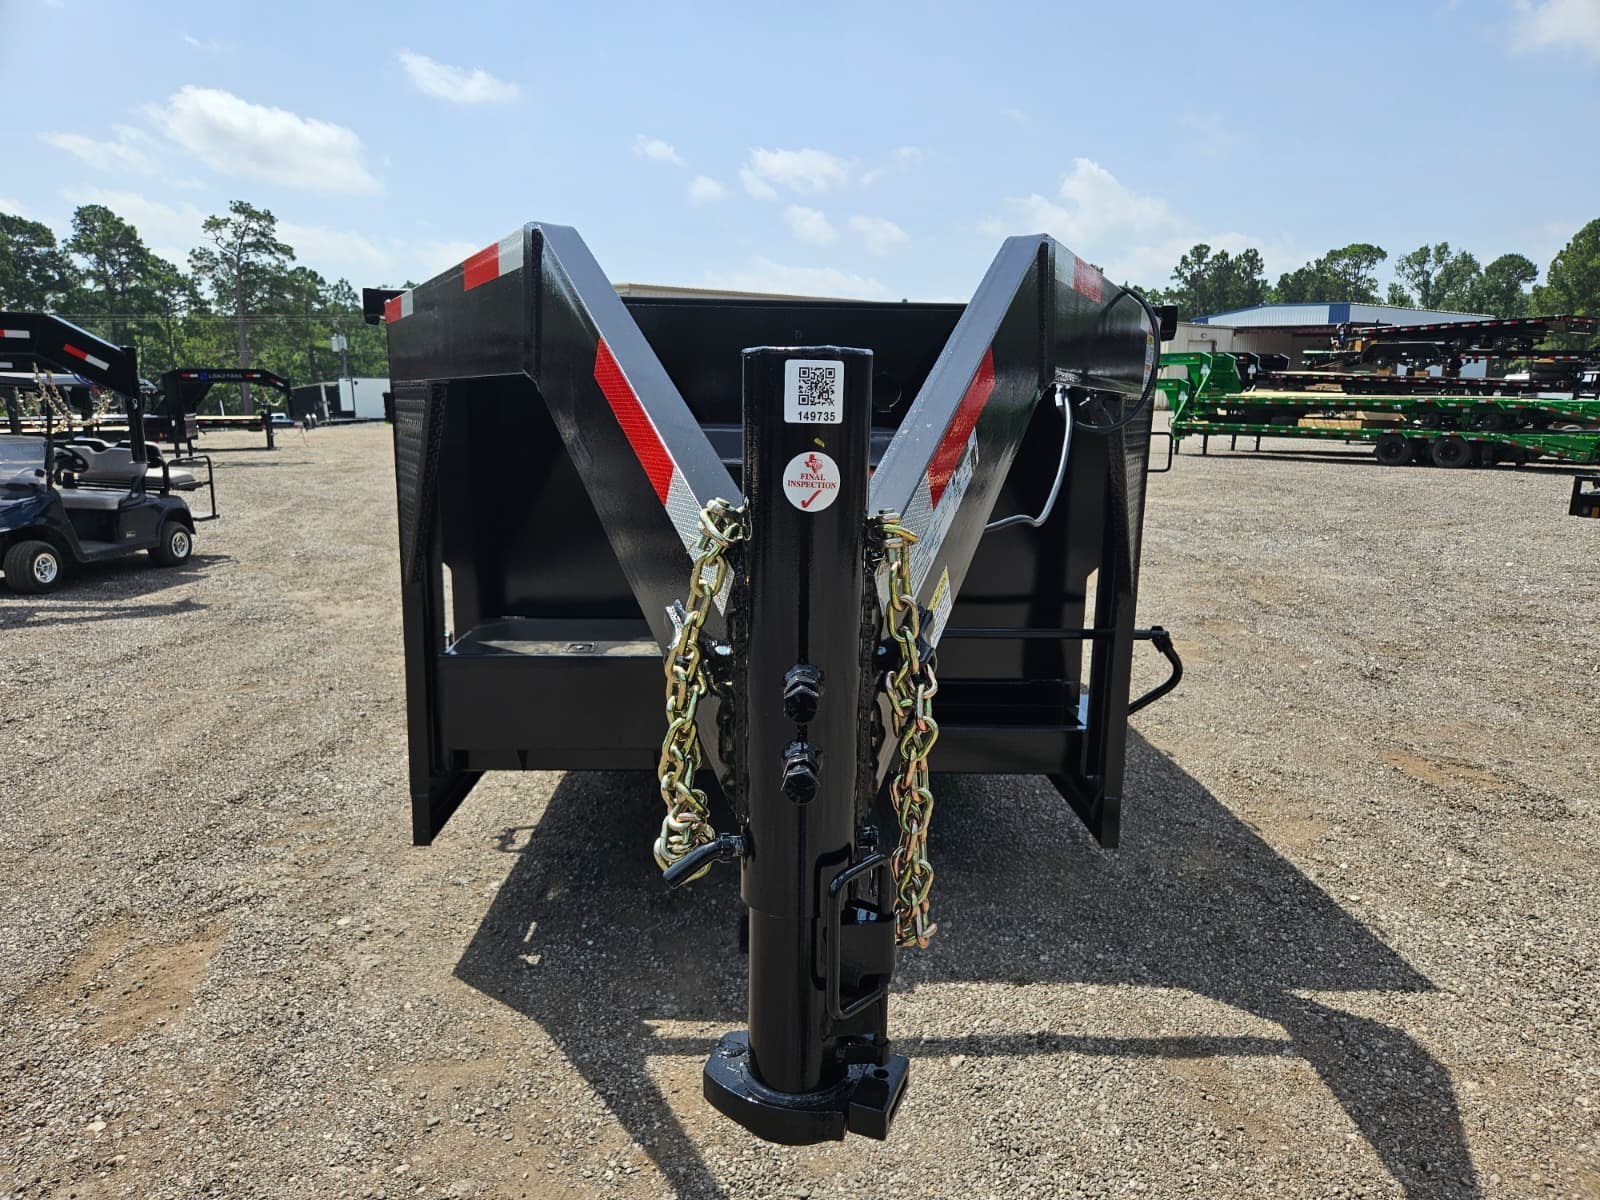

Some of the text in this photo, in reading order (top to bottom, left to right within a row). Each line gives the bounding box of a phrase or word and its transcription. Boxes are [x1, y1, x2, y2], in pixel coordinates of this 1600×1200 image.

[798, 411, 836, 422] 149735
[800, 473, 825, 481] FINAL
[787, 479, 836, 489] INSPECTION
